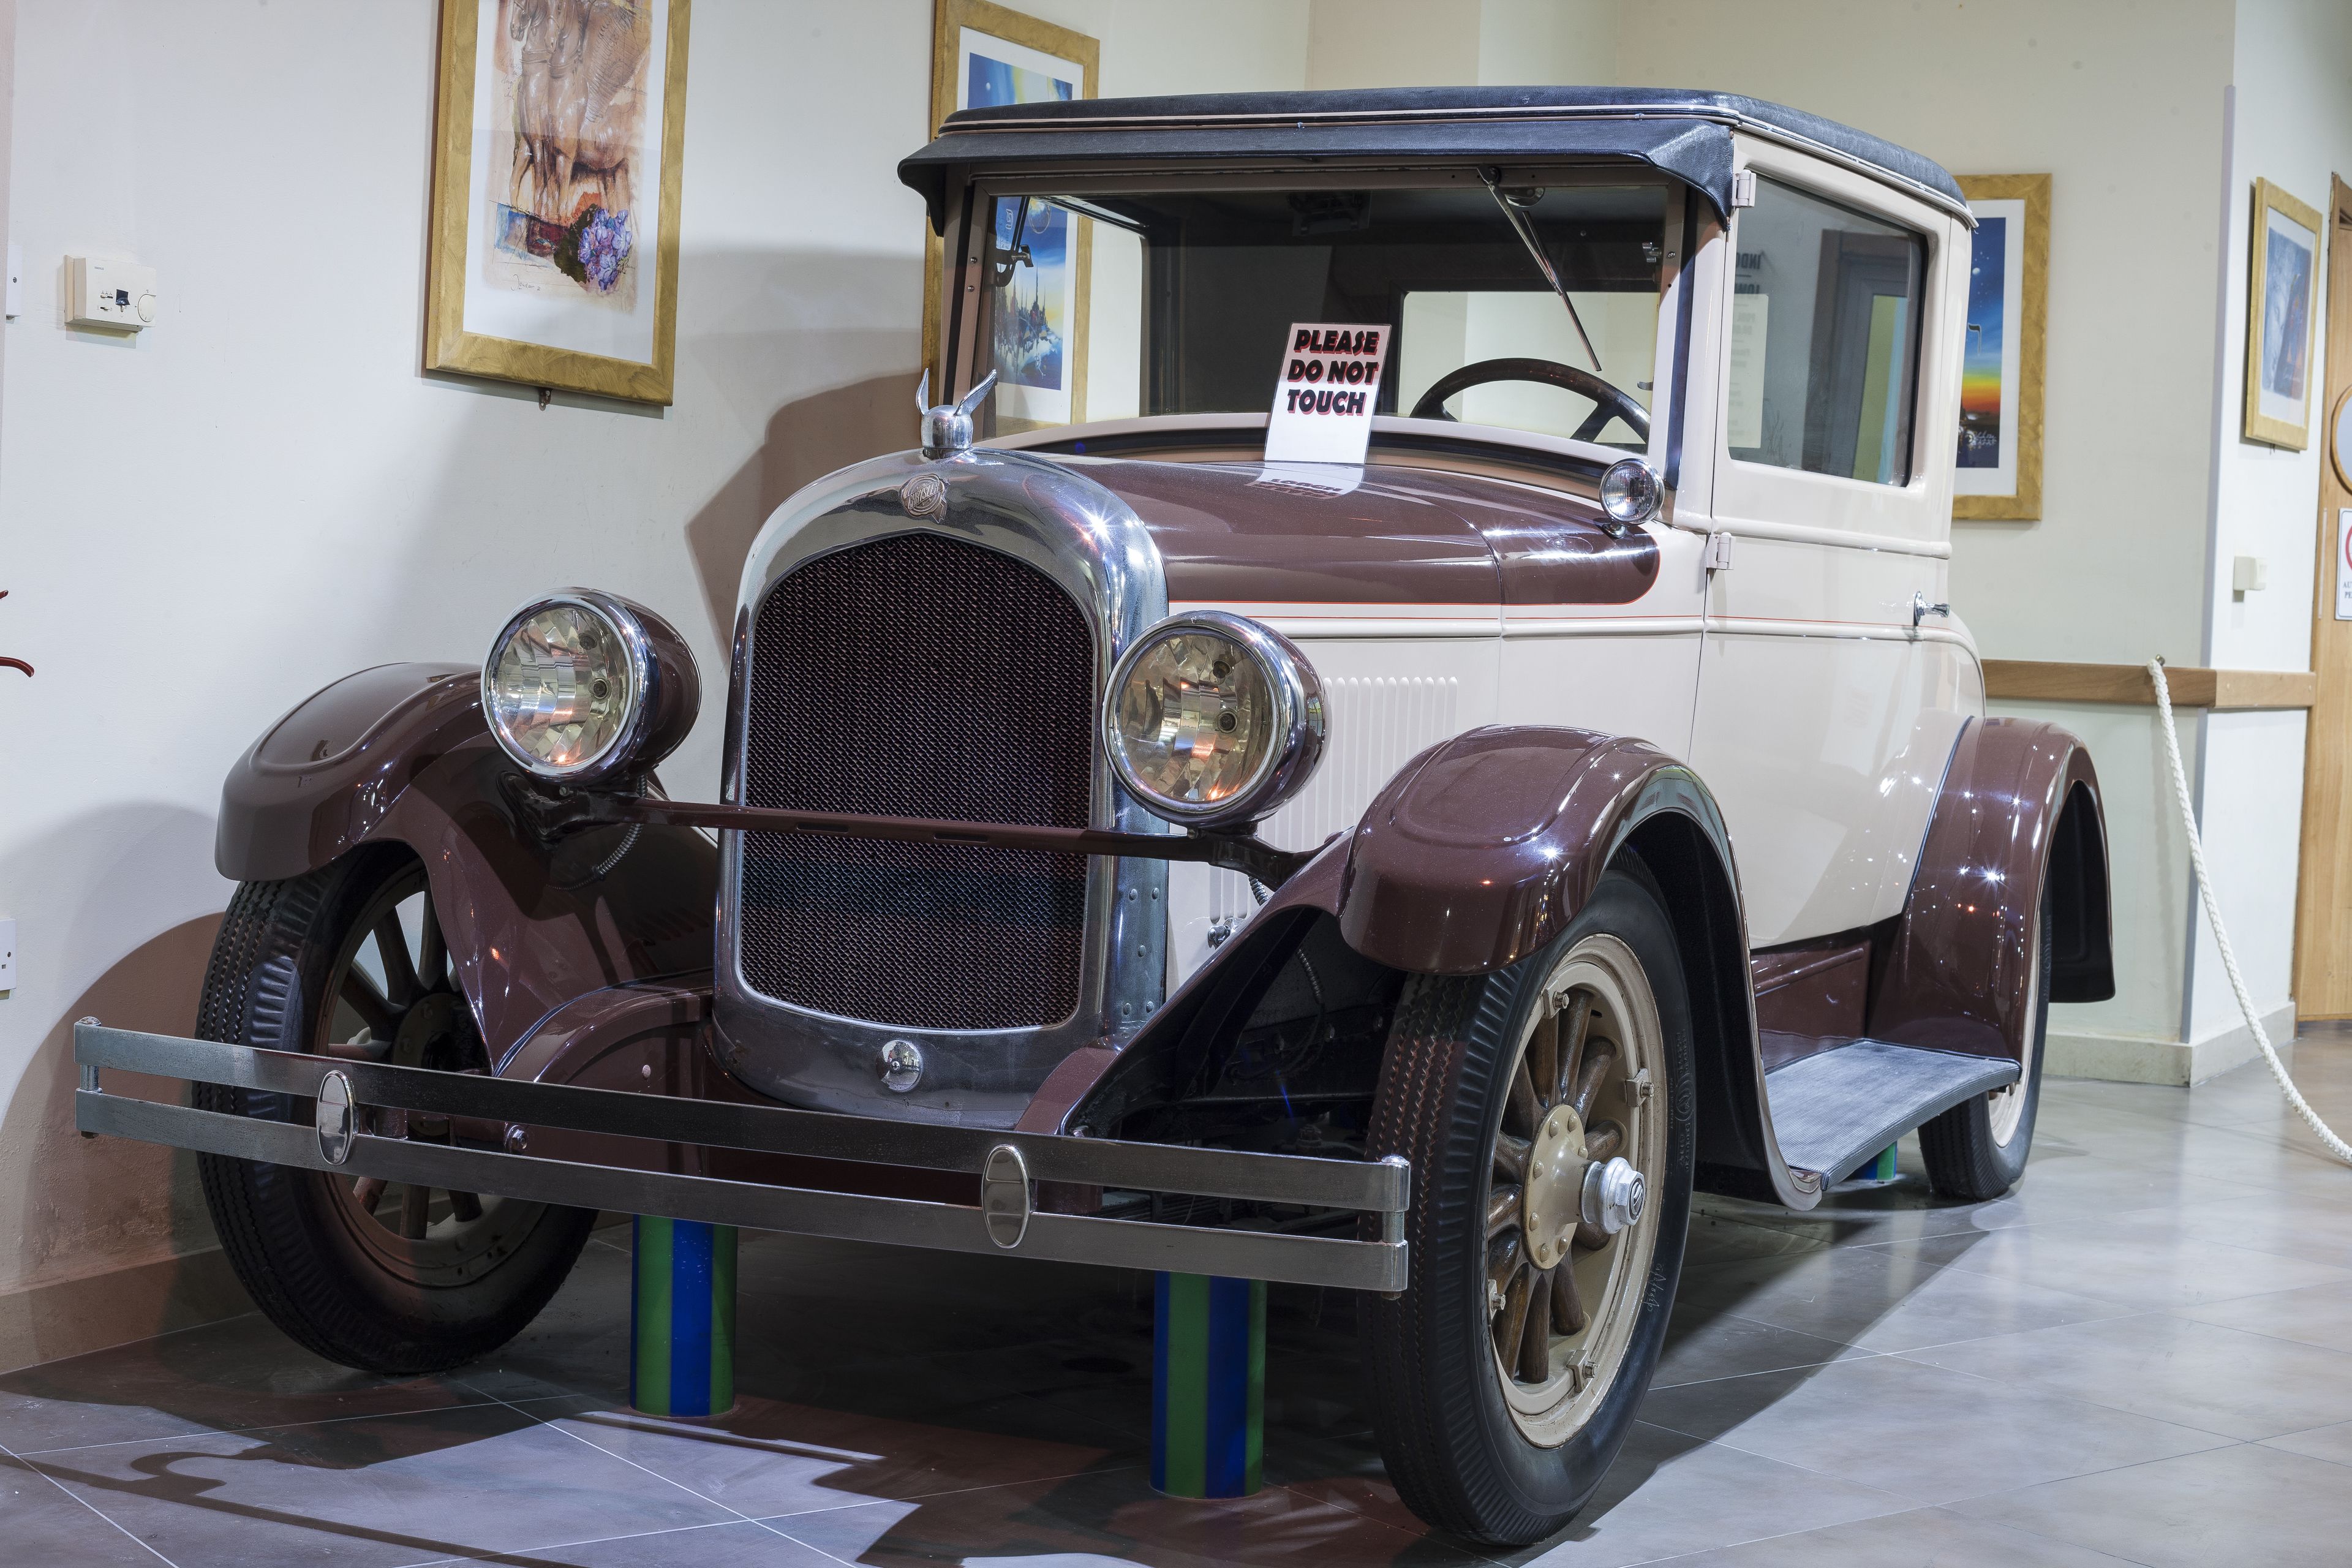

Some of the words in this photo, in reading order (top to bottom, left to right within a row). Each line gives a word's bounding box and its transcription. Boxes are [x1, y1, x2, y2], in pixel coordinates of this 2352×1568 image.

[1294, 329, 1379, 356] PLEASE
[1287, 359, 1324, 383] DO
[1327, 360, 1379, 385] NOT
[1287, 389, 1367, 417] TOUCH
[908, 480, 940, 509] CHRYSLER
